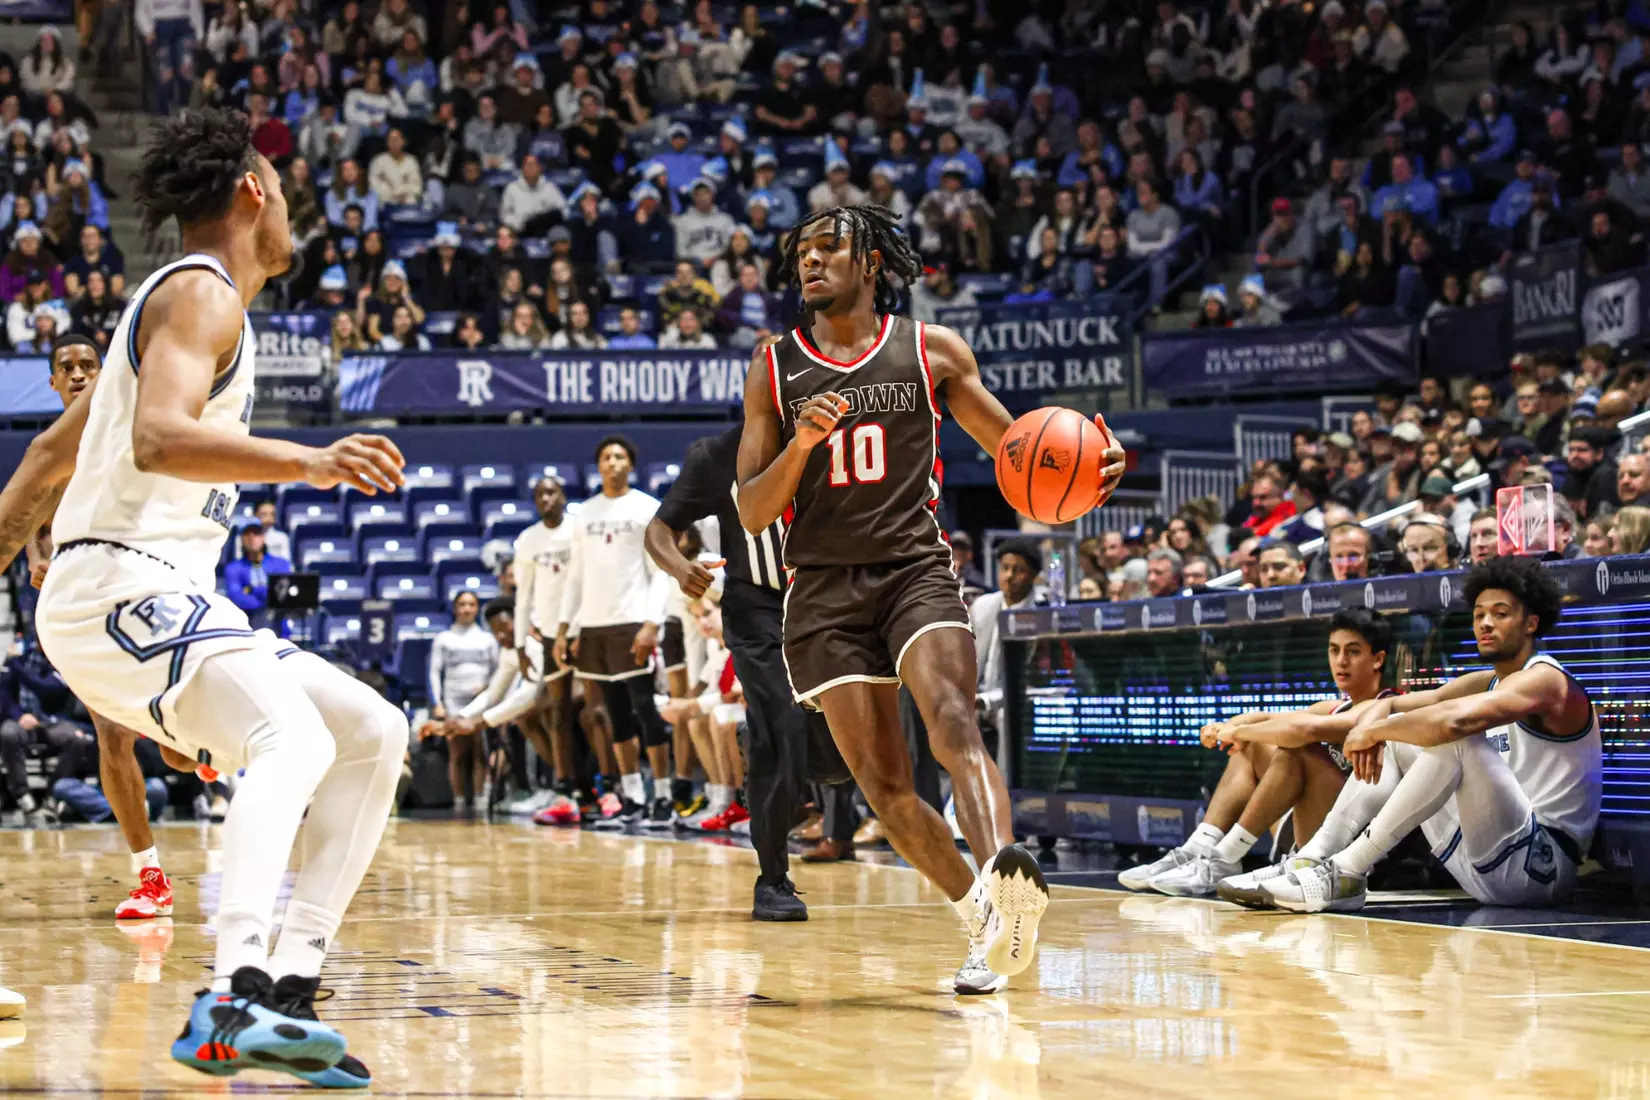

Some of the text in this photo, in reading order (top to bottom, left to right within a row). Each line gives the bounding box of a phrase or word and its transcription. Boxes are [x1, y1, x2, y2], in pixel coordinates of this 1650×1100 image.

[542, 360, 594, 403] THE
[601, 360, 692, 403] RHODY
[982, 356, 1124, 392] STER BAR
[272, 385, 322, 401] MOLD
[826, 421, 888, 488] 10
[368, 616, 386, 645] 3
